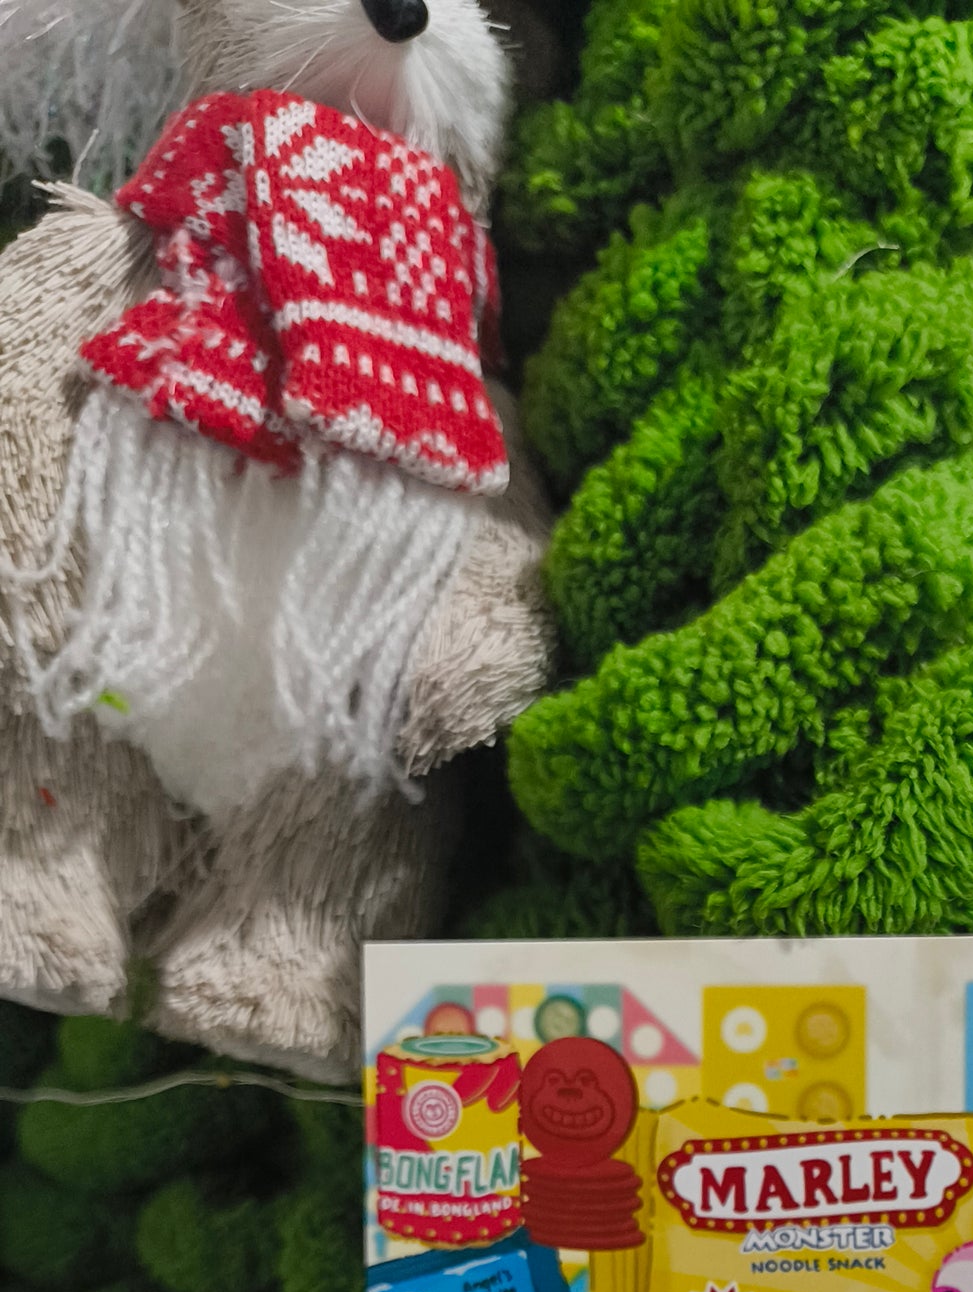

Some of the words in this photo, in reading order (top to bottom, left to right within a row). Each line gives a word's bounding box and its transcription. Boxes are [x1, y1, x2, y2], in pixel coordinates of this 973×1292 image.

[700, 1150, 936, 1214] MARLEY
[741, 1225, 895, 1253] MONSTER
[751, 1260, 820, 1273] NOODLE
[828, 1257, 886, 1272] SNACK
